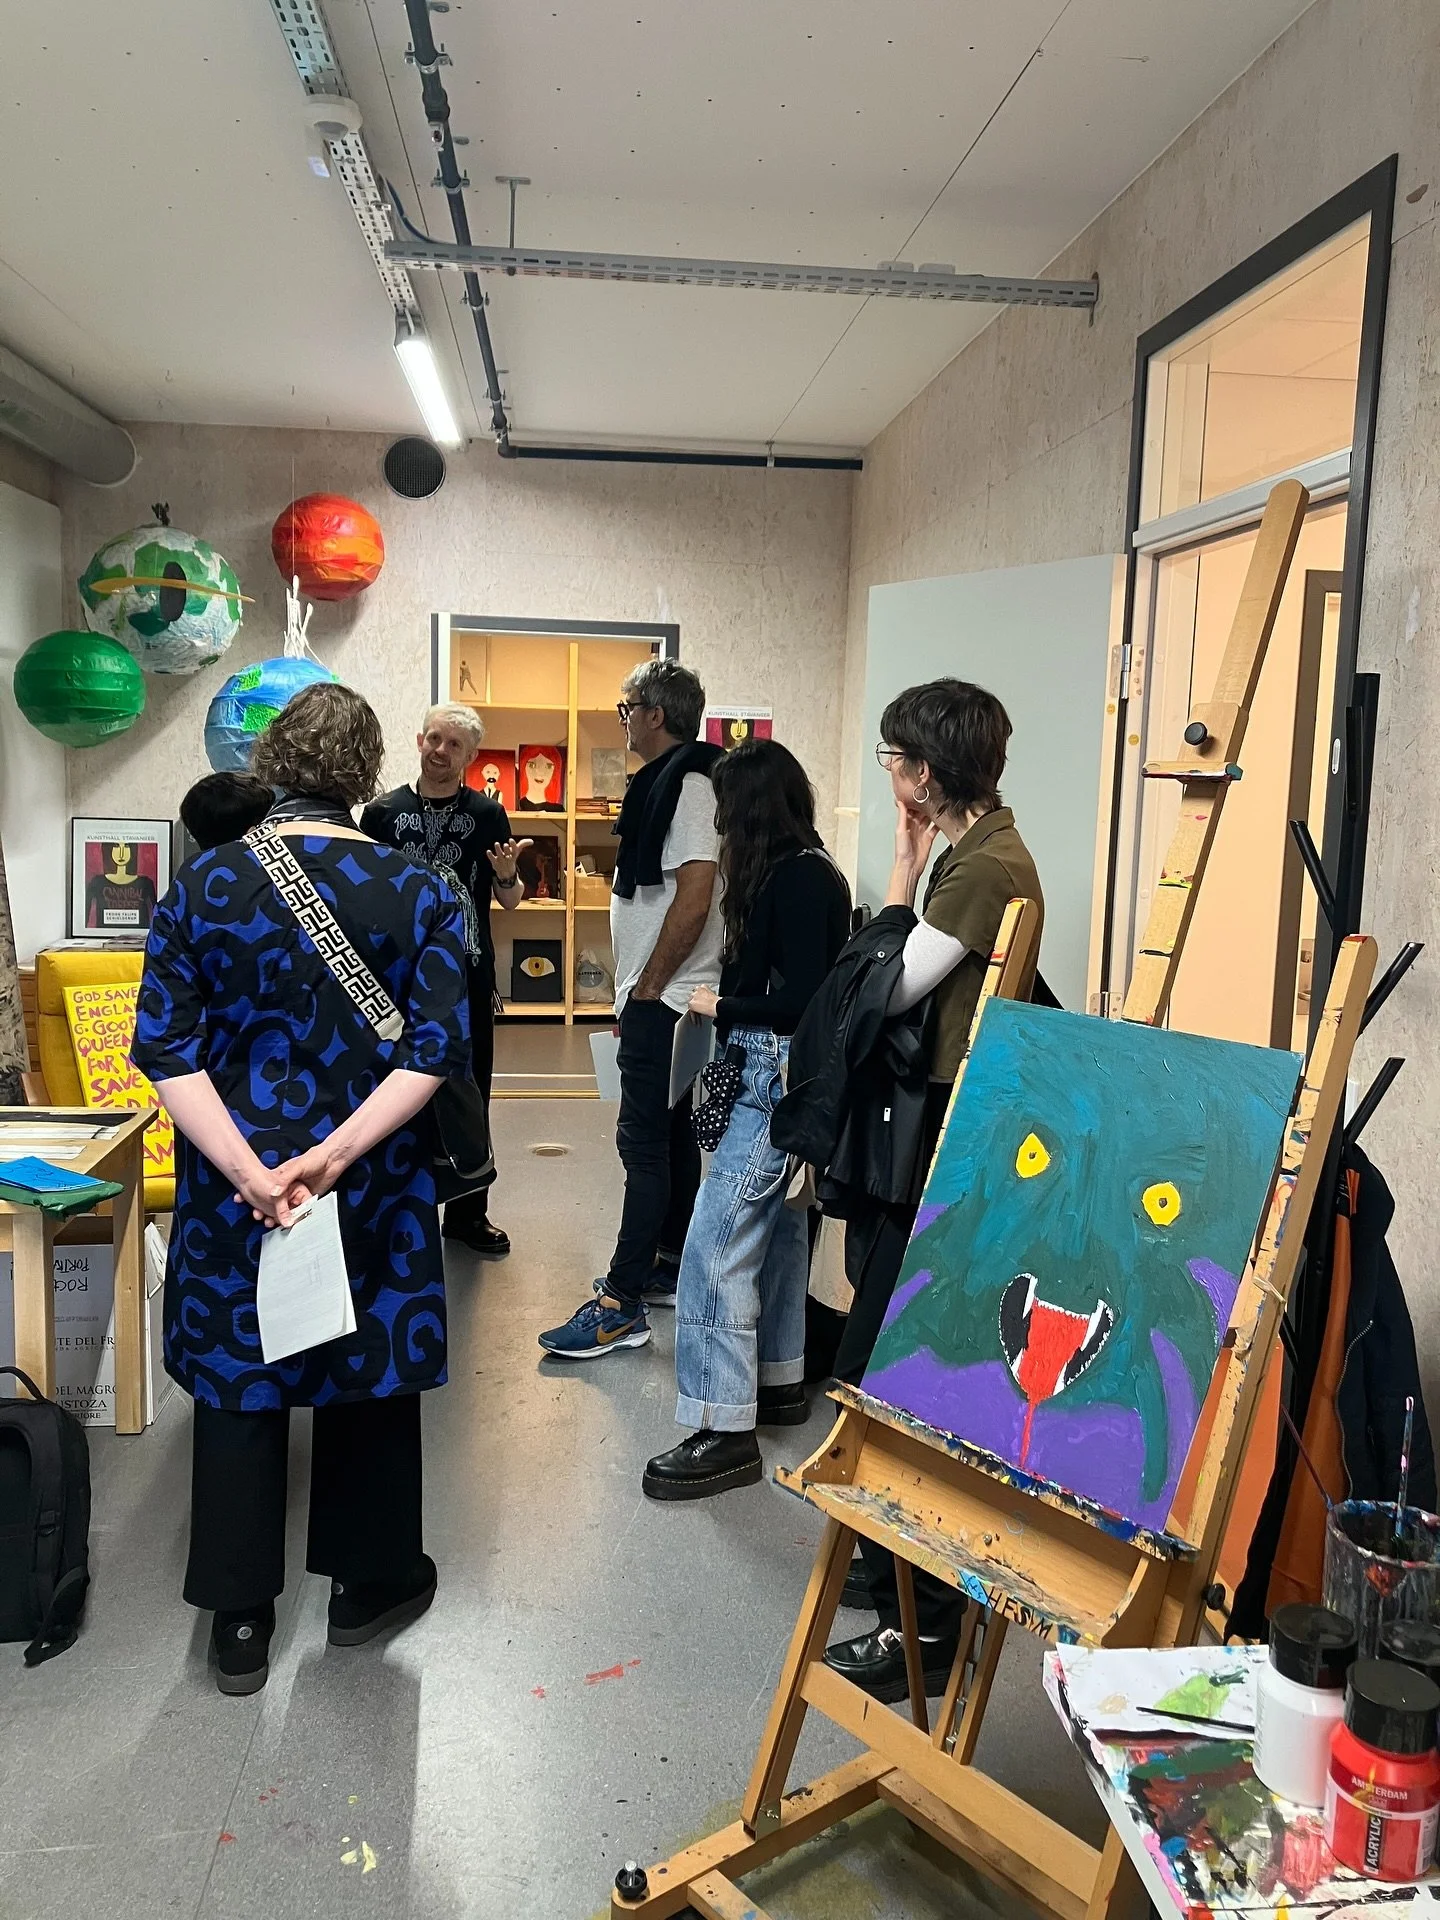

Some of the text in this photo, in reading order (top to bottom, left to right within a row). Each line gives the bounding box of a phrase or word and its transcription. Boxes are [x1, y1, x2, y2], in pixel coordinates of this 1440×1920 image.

[73, 986, 137, 1003] GOD SAVE
[76, 1003, 136, 1021] ENGLA
[88, 1055, 119, 1076] FOR
[90, 1073, 143, 1102] SAVE
[56, 1335, 115, 1346] TE DEL FR
[56, 1399, 107, 1409] USTOZA
[1351, 1775, 1408, 1800] AMSTERDAM
[1367, 1817, 1381, 1867] ACRYLIC
